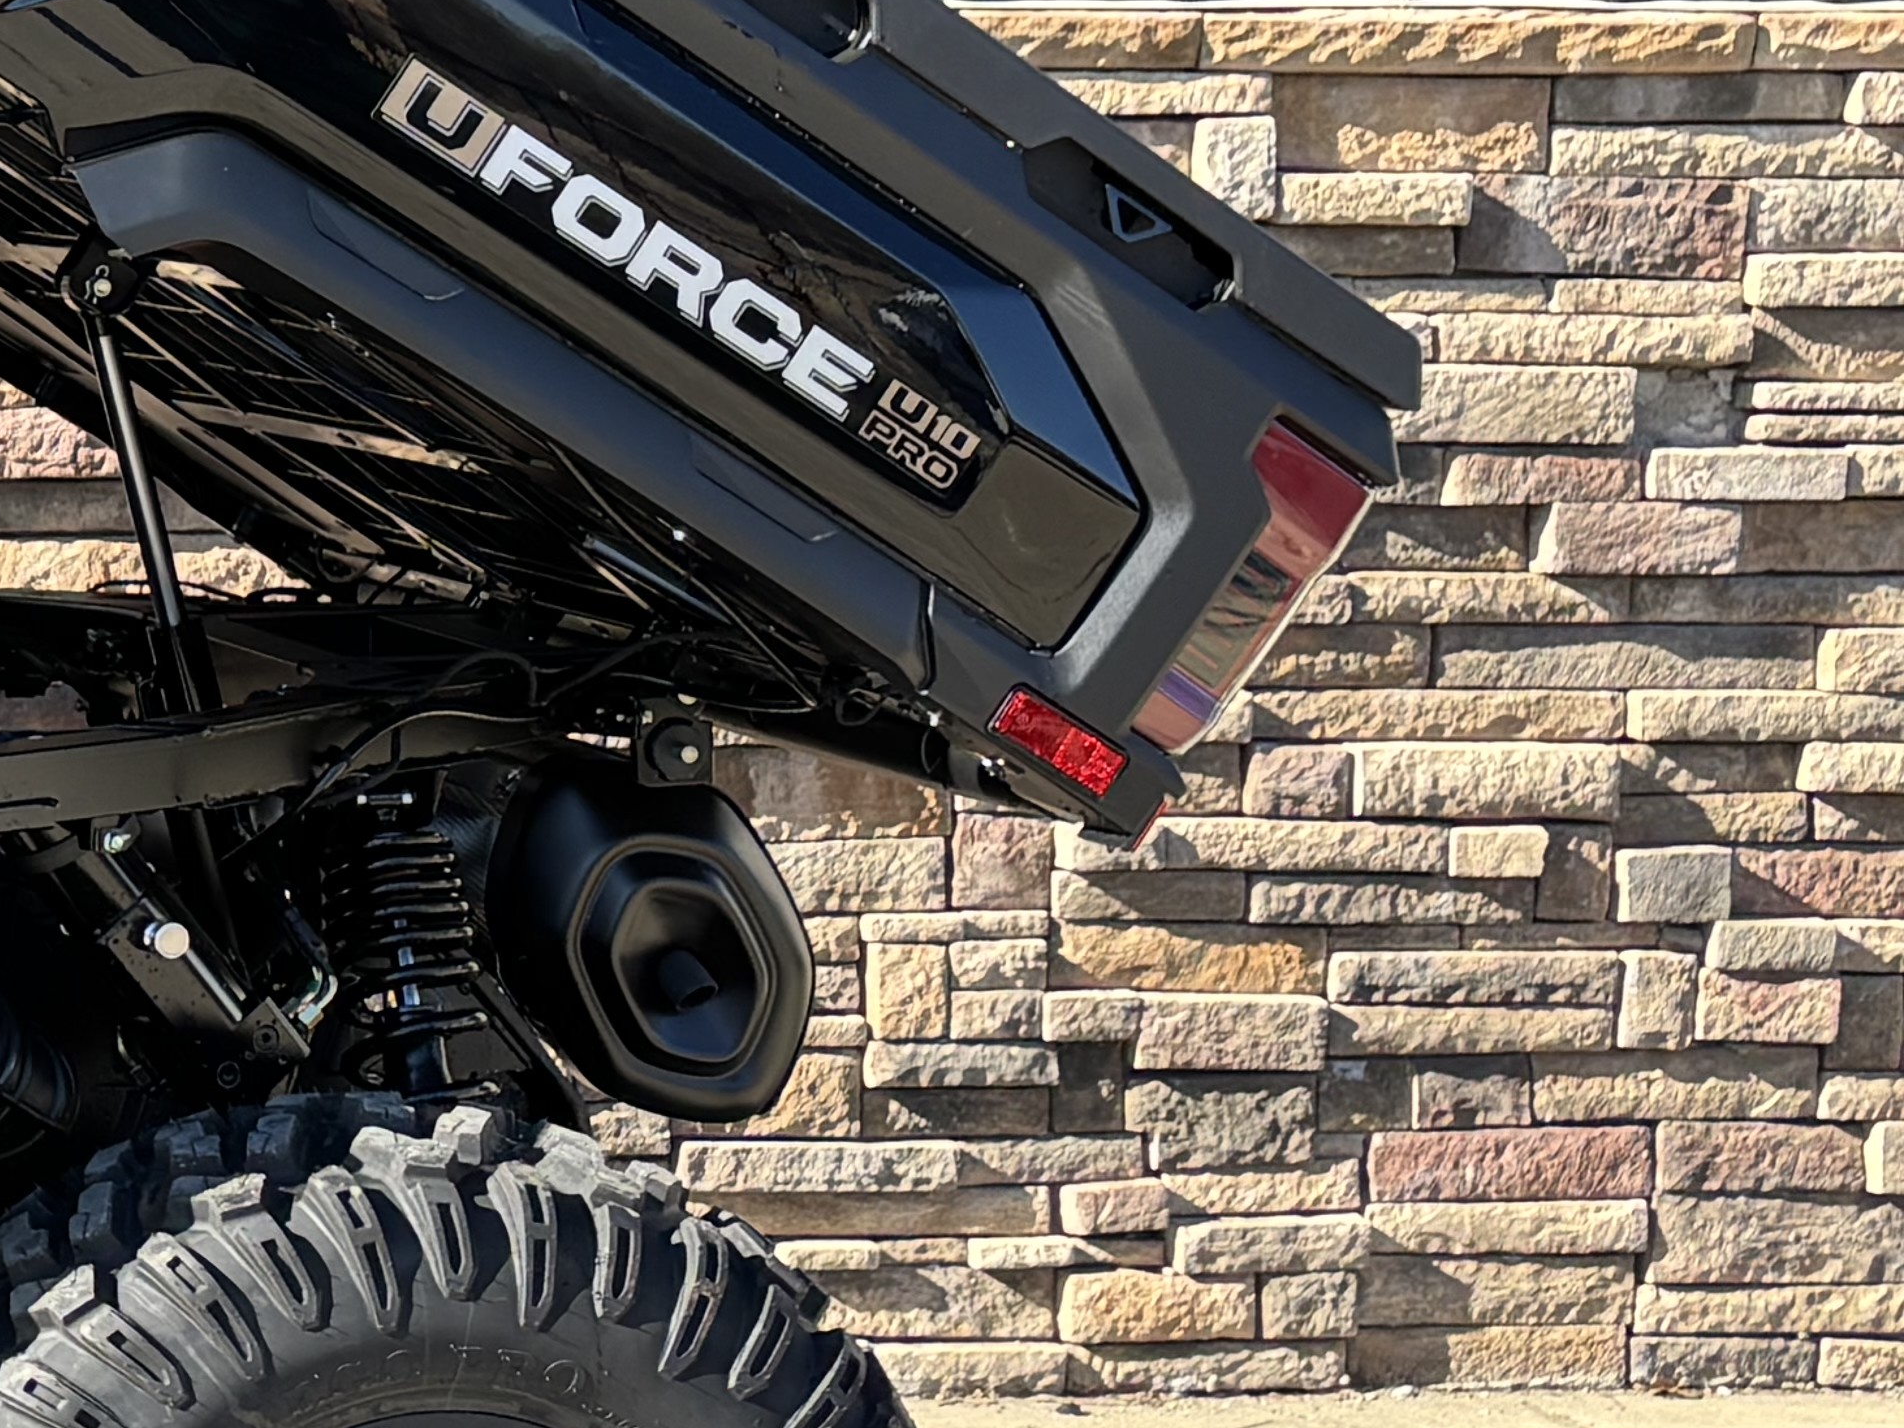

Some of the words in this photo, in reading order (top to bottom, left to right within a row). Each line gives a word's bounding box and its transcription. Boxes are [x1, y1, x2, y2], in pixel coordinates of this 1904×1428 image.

[373, 54, 874, 422] UFORCE
[858, 412, 960, 491] PRO
[879, 379, 981, 461] U10
